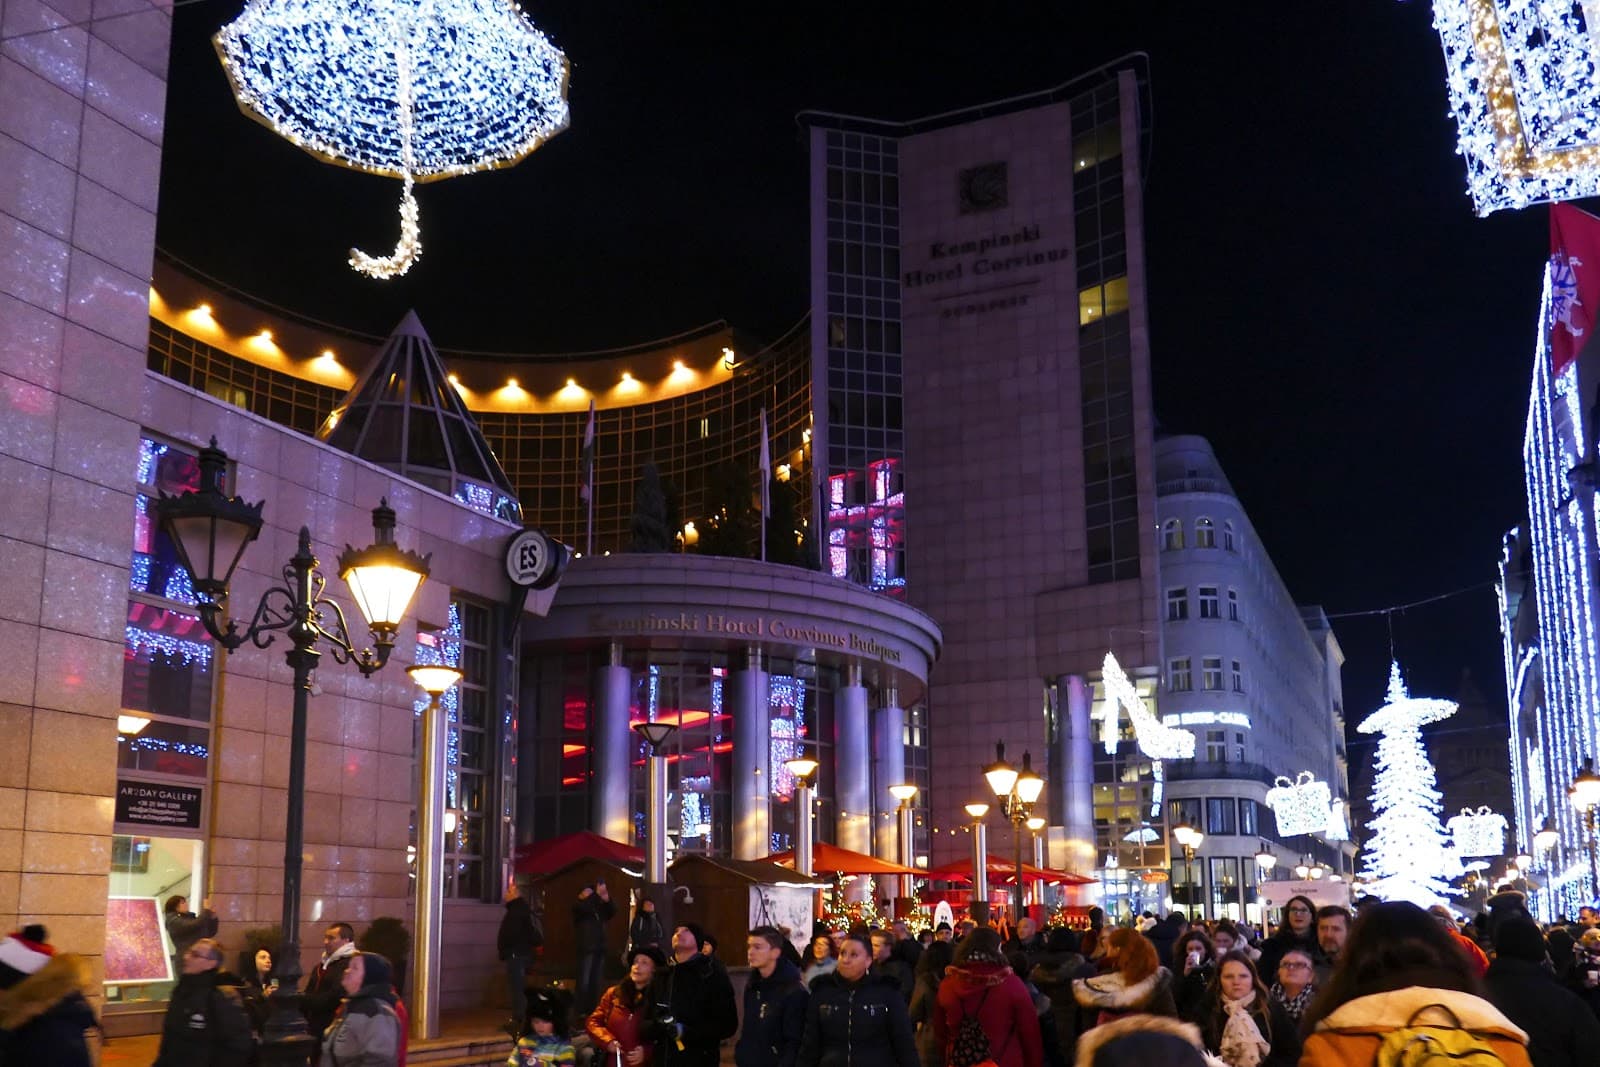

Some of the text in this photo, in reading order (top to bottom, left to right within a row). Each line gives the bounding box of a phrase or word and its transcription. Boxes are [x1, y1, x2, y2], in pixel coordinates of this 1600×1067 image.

[931, 224, 1040, 259] Kempinski
[904, 247, 1069, 288] Hotel Corvinus
[706, 614, 763, 635] Hotel
[768, 618, 846, 648] Corvinus
[848, 632, 902, 663] Budapest
[159, 791, 198, 801] GALLERY
